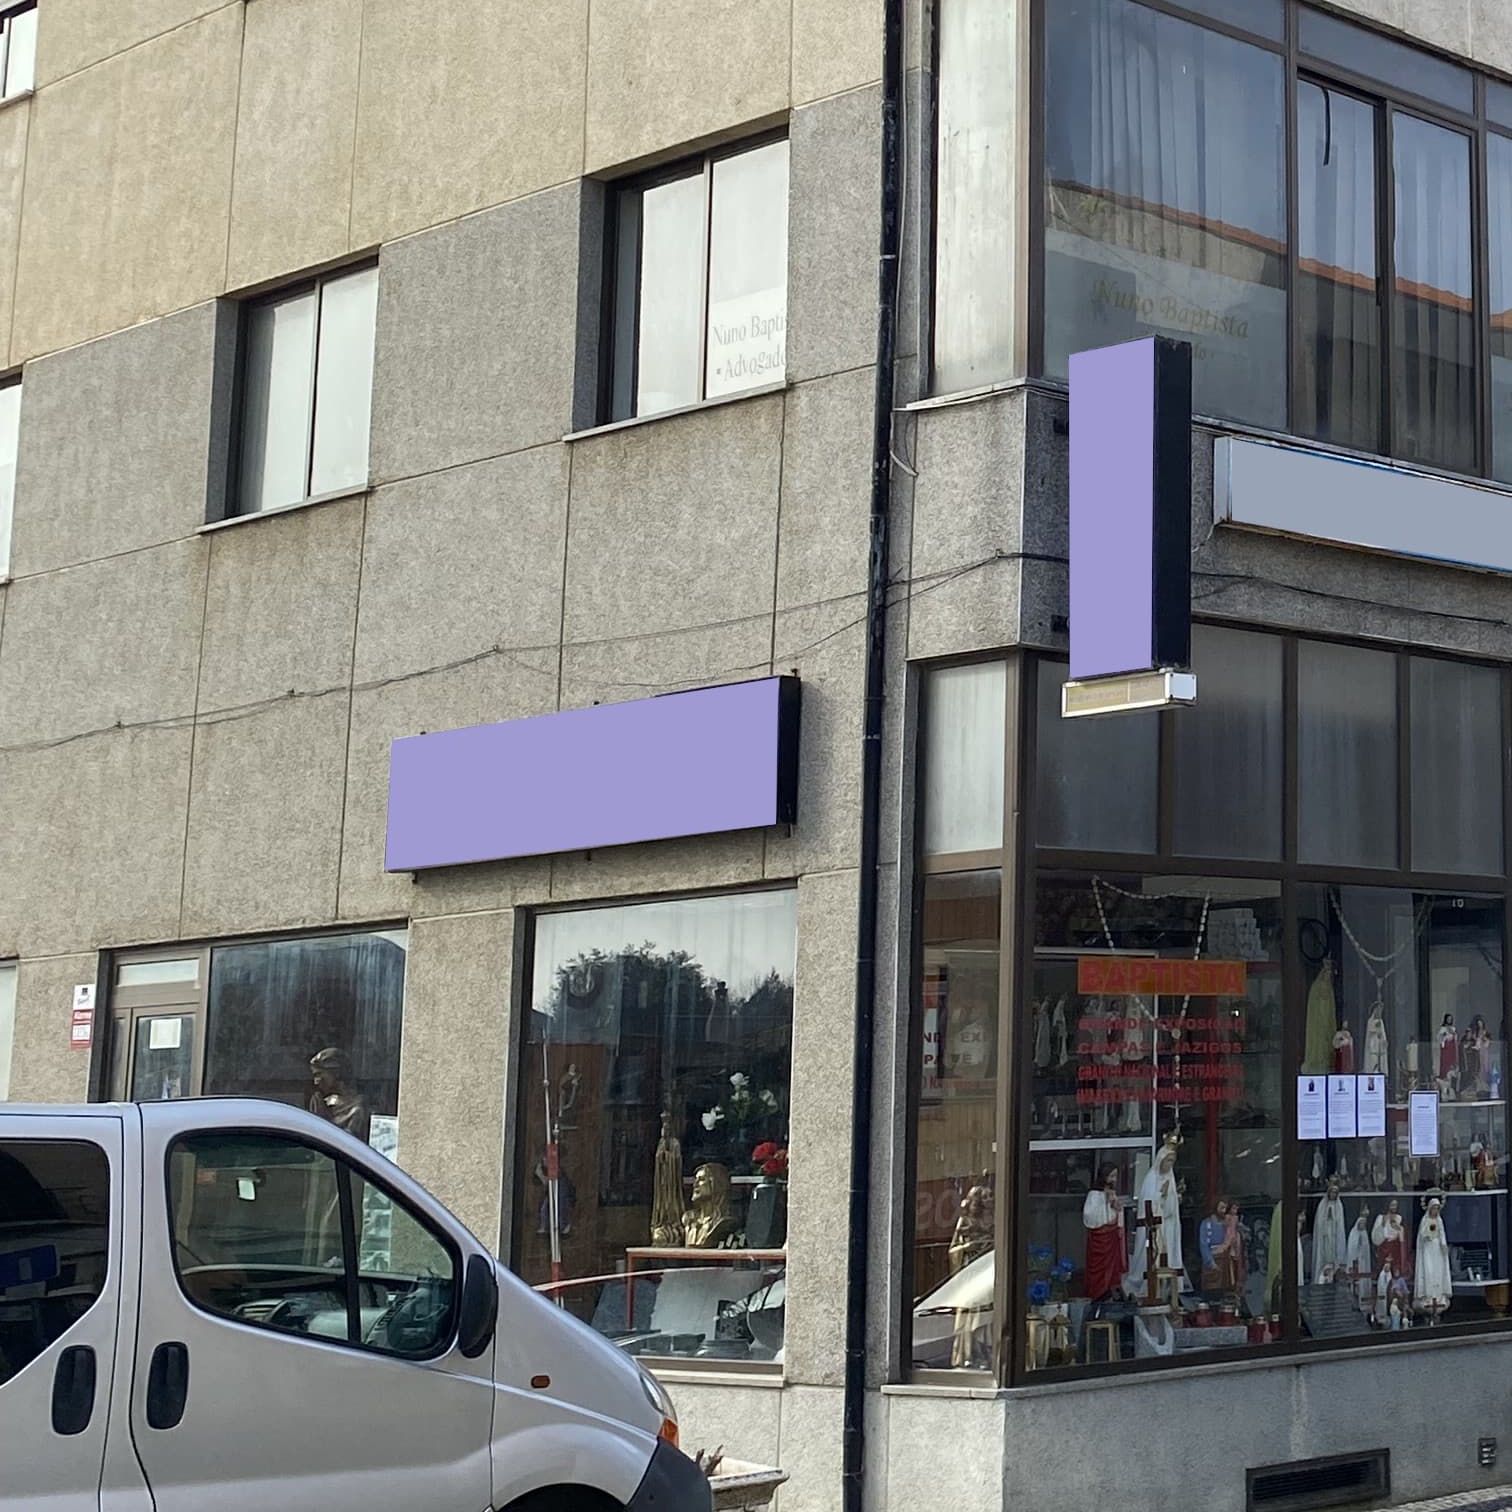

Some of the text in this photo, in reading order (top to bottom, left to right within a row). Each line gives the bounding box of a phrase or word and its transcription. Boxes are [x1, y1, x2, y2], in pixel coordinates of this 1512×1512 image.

[712, 313, 787, 345] Nuno Bapti
[1081, 961, 1245, 994] BAPTISTA
